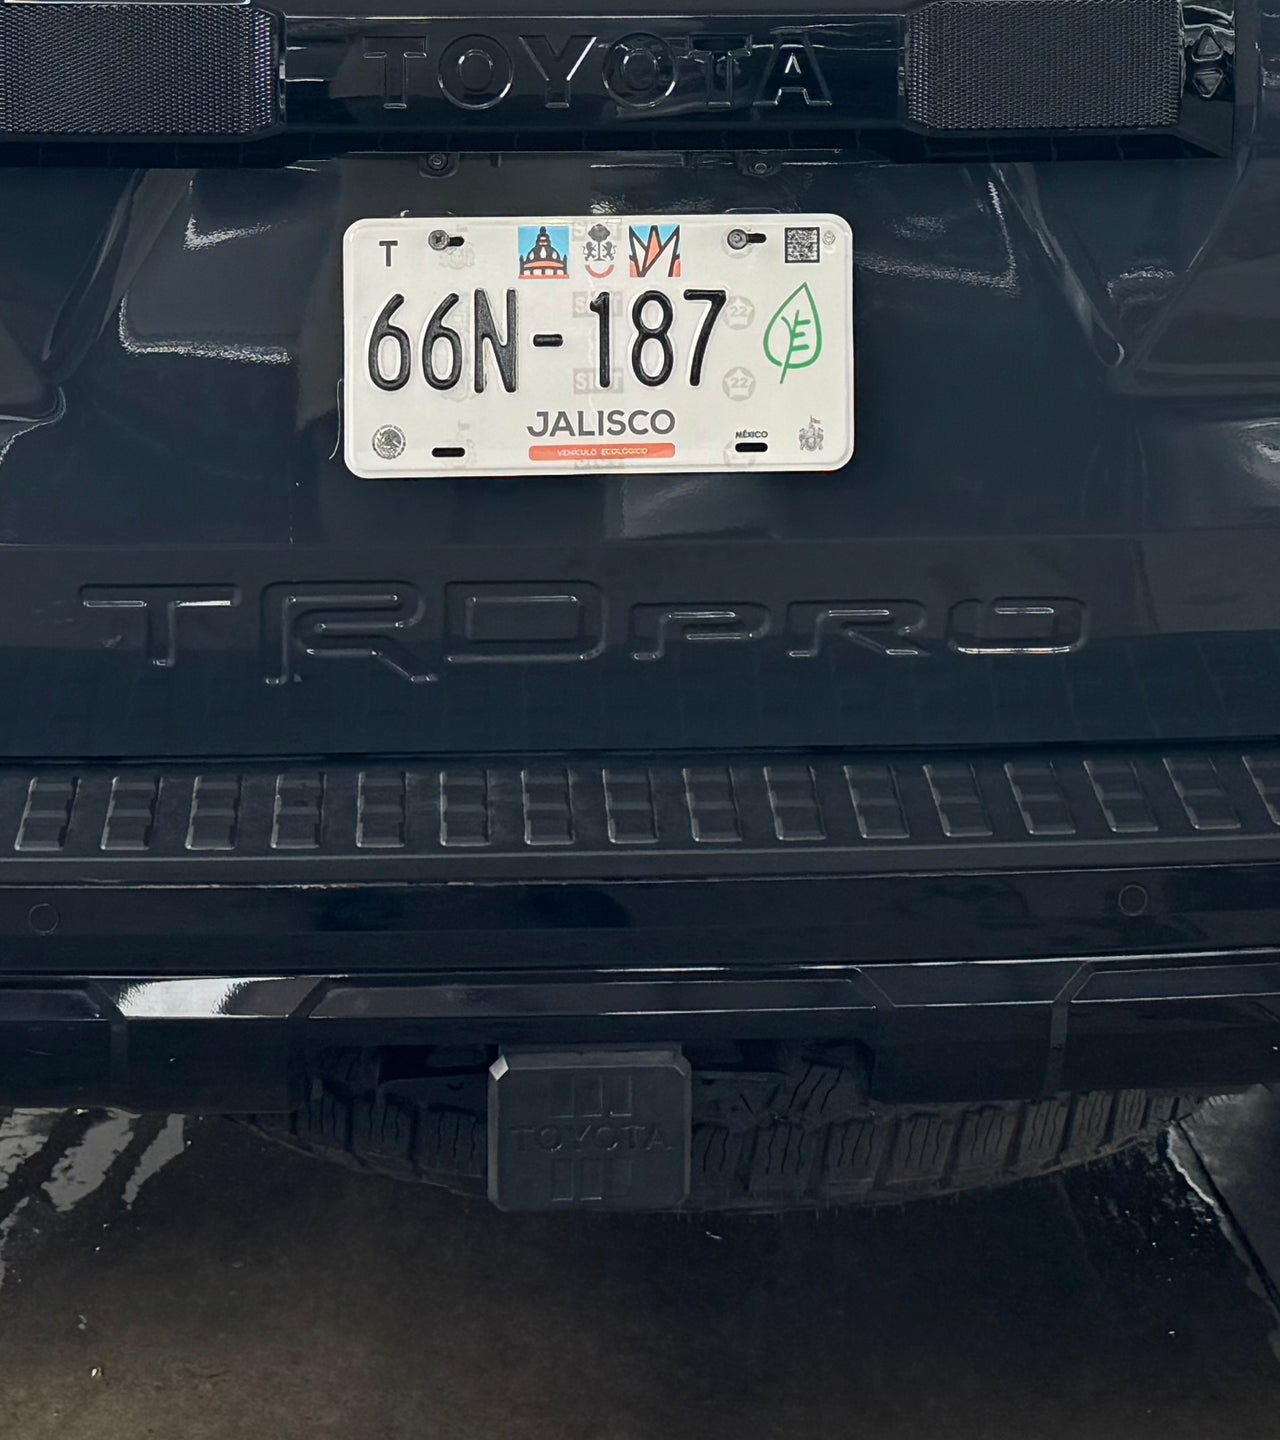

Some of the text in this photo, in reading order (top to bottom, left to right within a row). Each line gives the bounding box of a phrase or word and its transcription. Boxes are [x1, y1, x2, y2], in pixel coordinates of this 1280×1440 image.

[362, 32, 834, 110] TOYOTA
[378, 240, 399, 268] T
[366, 287, 727, 394] 66N-187
[525, 408, 676, 438] JALISCO
[735, 428, 769, 439] MÉXICO
[510, 1124, 673, 1153] TOYOTA
